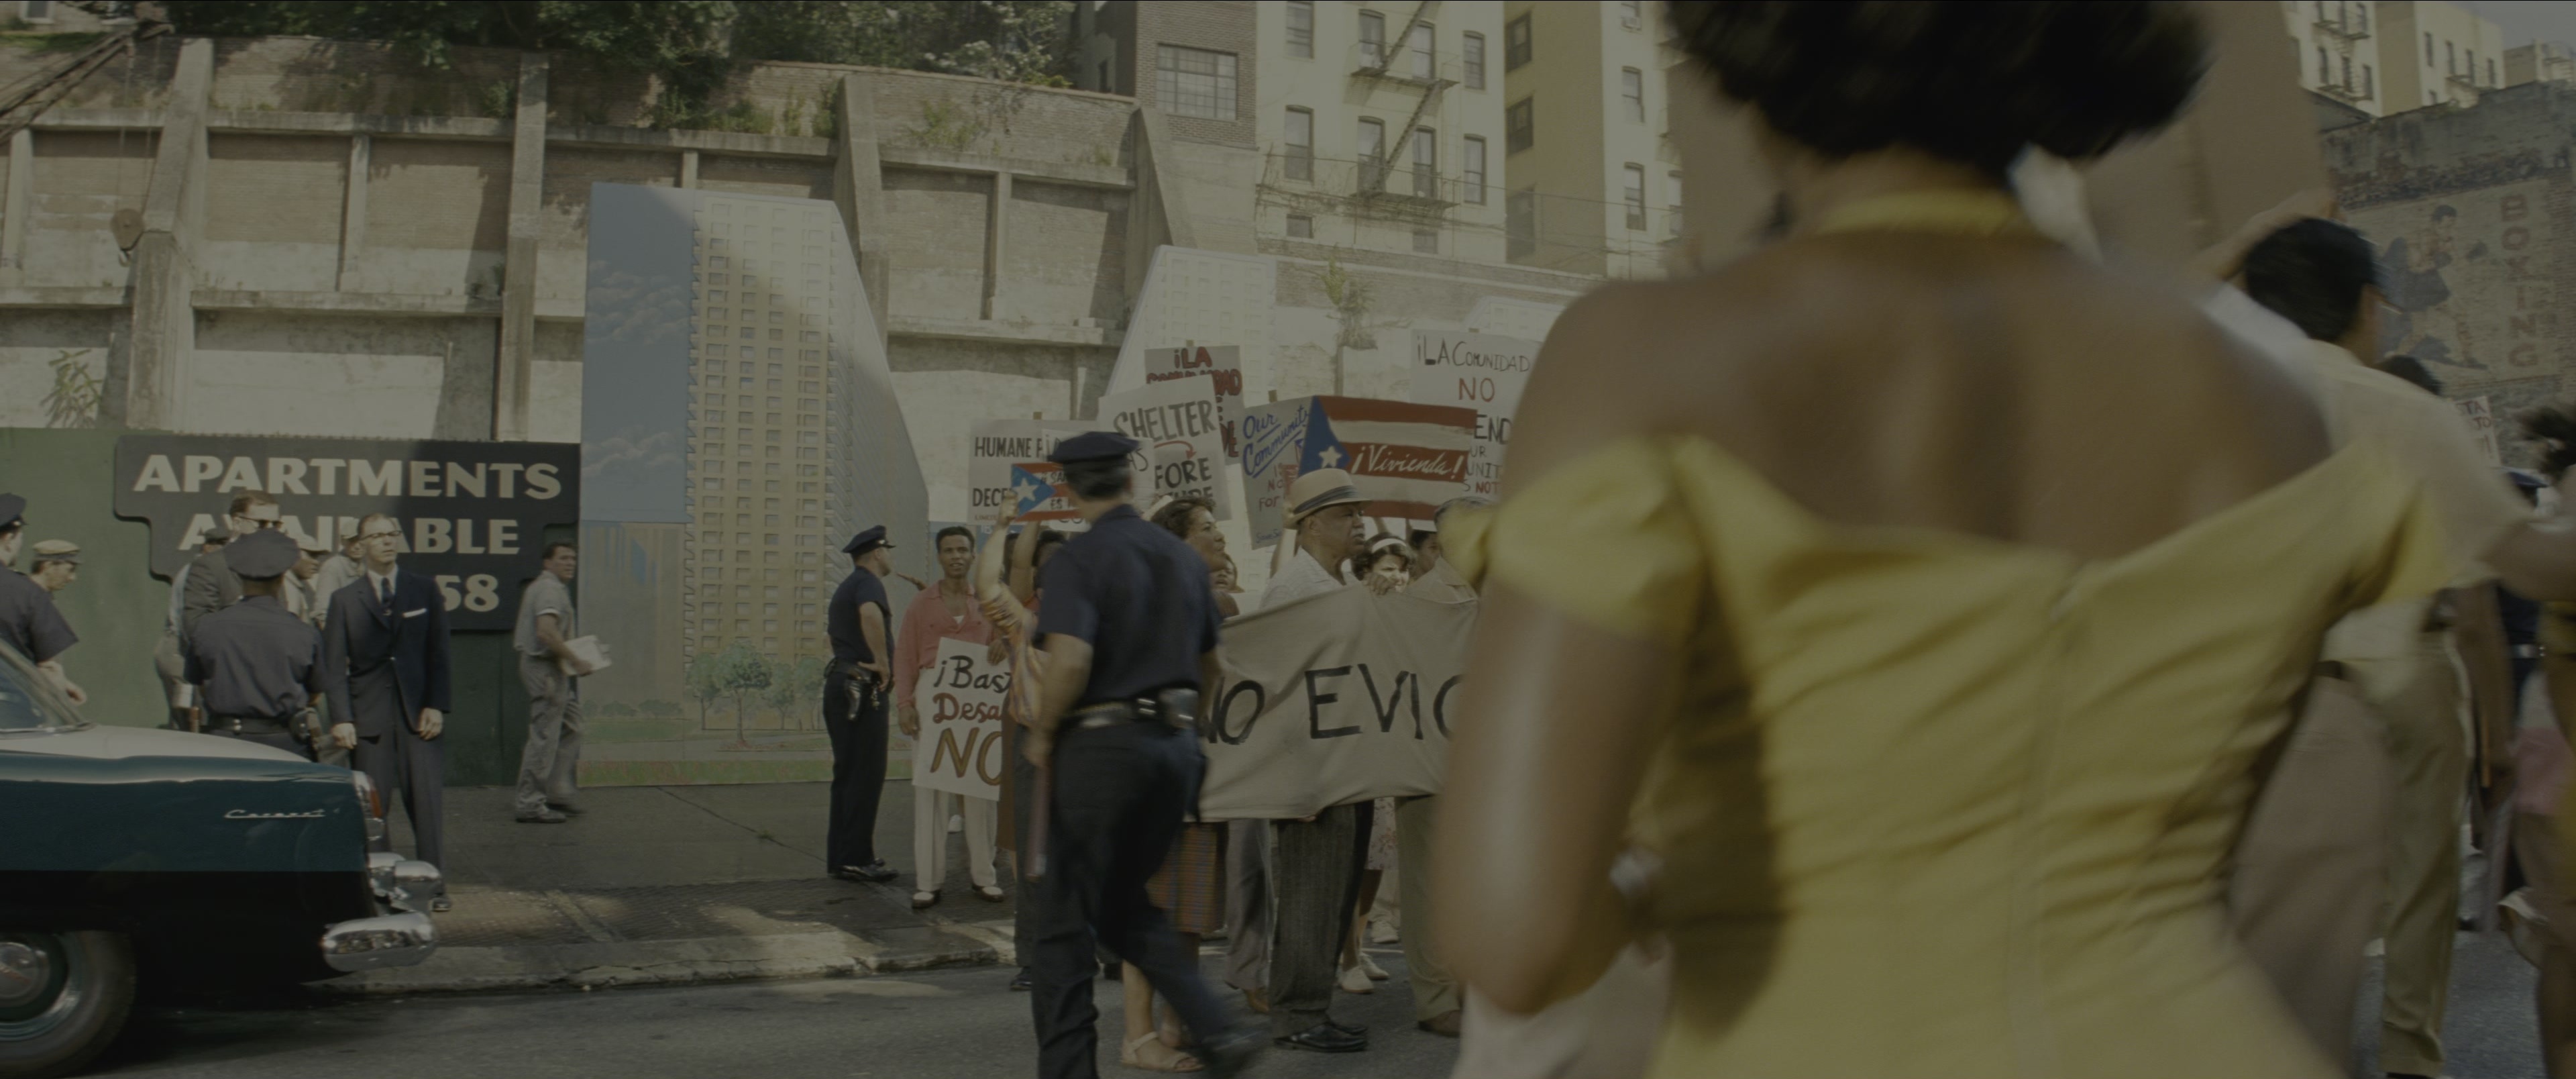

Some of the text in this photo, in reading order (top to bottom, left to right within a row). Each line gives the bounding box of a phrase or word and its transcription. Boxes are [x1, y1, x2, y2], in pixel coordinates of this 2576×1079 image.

[2499, 193, 2538, 368] BOXING
[1458, 377, 1495, 403] NO
[1114, 401, 1216, 442] SHELTER
[1243, 413, 1278, 439] Our
[975, 437, 1032, 458] HUMANE
[133, 454, 561, 501] APARTMENTS
[178, 513, 520, 555] AILBLE
[930, 727, 1002, 786] NO
